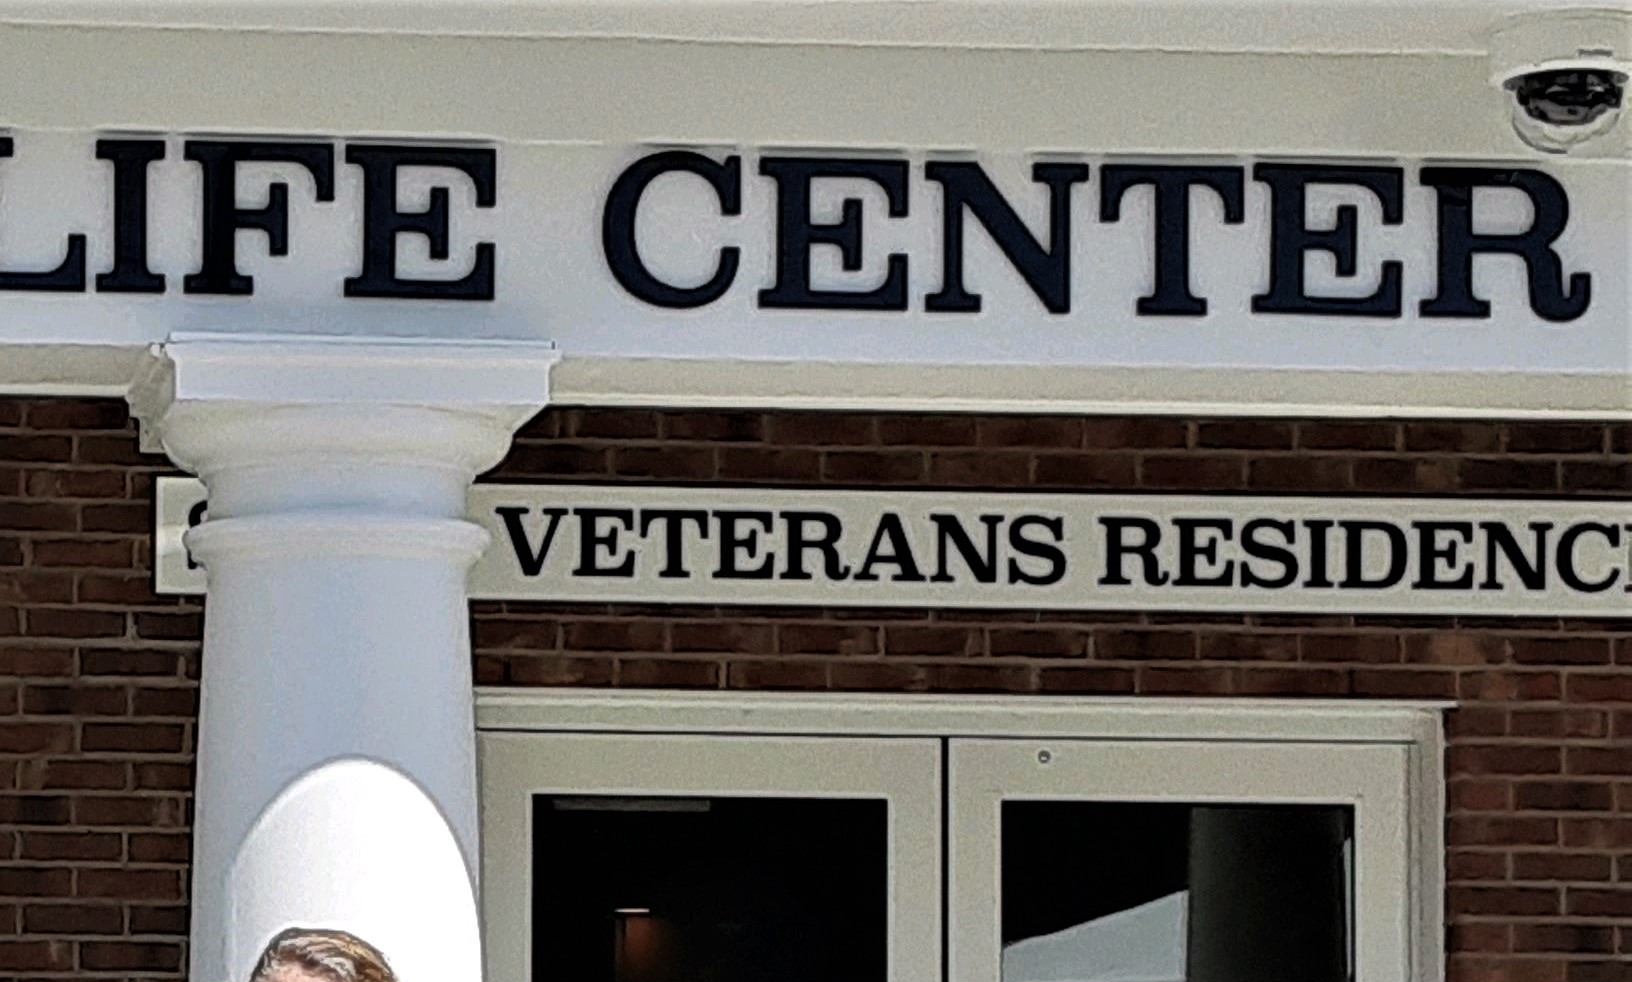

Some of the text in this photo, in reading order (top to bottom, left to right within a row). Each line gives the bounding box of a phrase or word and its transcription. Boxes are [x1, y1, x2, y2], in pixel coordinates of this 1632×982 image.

[601, 149, 1592, 323] CENTER
[494, 506, 1632, 594] VETERANS RESIDENC
